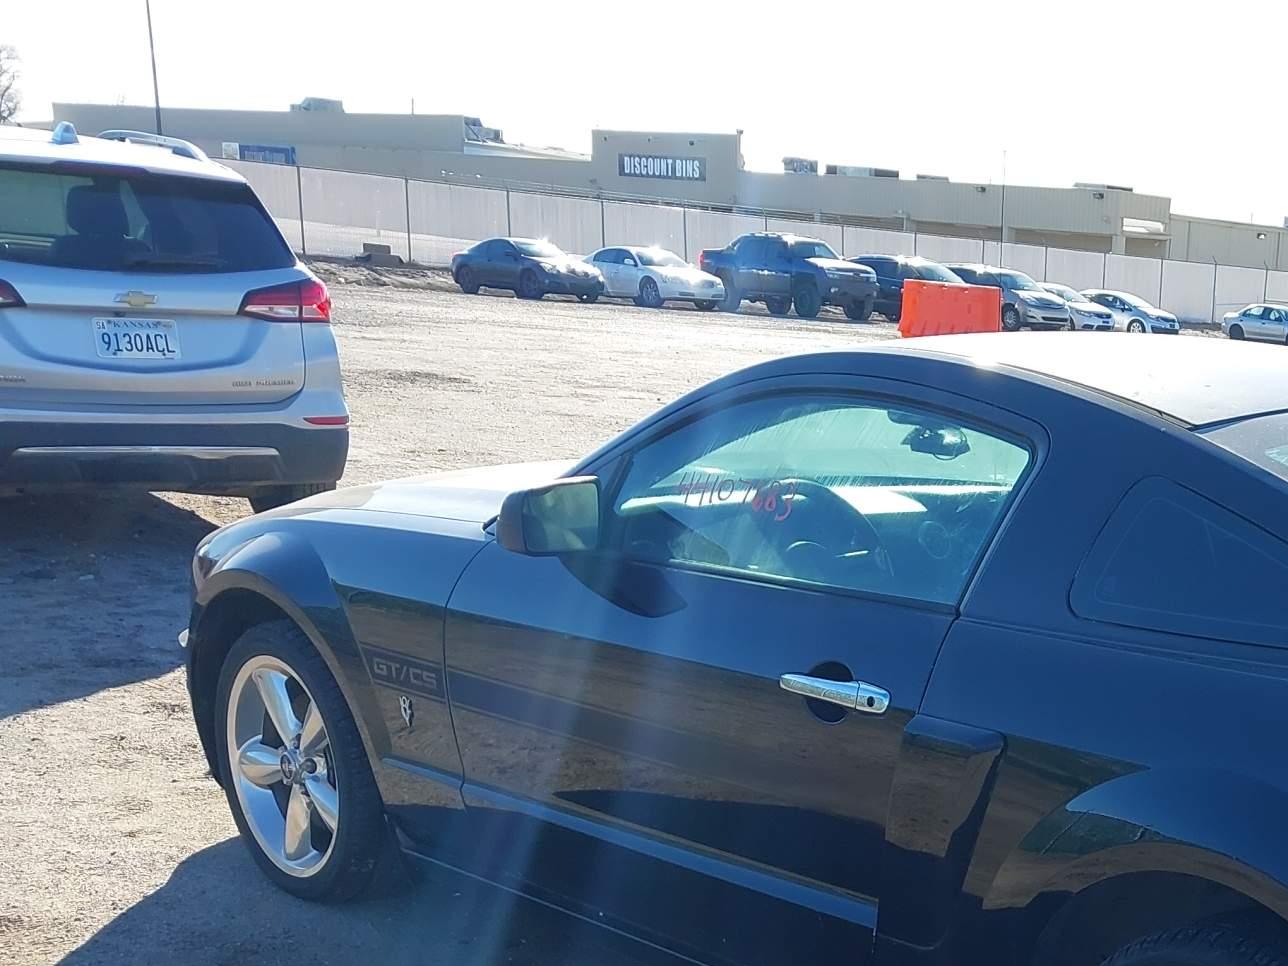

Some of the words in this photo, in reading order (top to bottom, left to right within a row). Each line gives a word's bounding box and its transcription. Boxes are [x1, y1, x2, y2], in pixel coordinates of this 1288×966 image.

[624, 156, 672, 176] DISCOUNT
[676, 159, 700, 178] BINS
[113, 320, 159, 329] KANSAS
[101, 332, 176, 353] 9130ACL
[679, 471, 797, 521] 44107683
[373, 658, 437, 689] GT/CS
